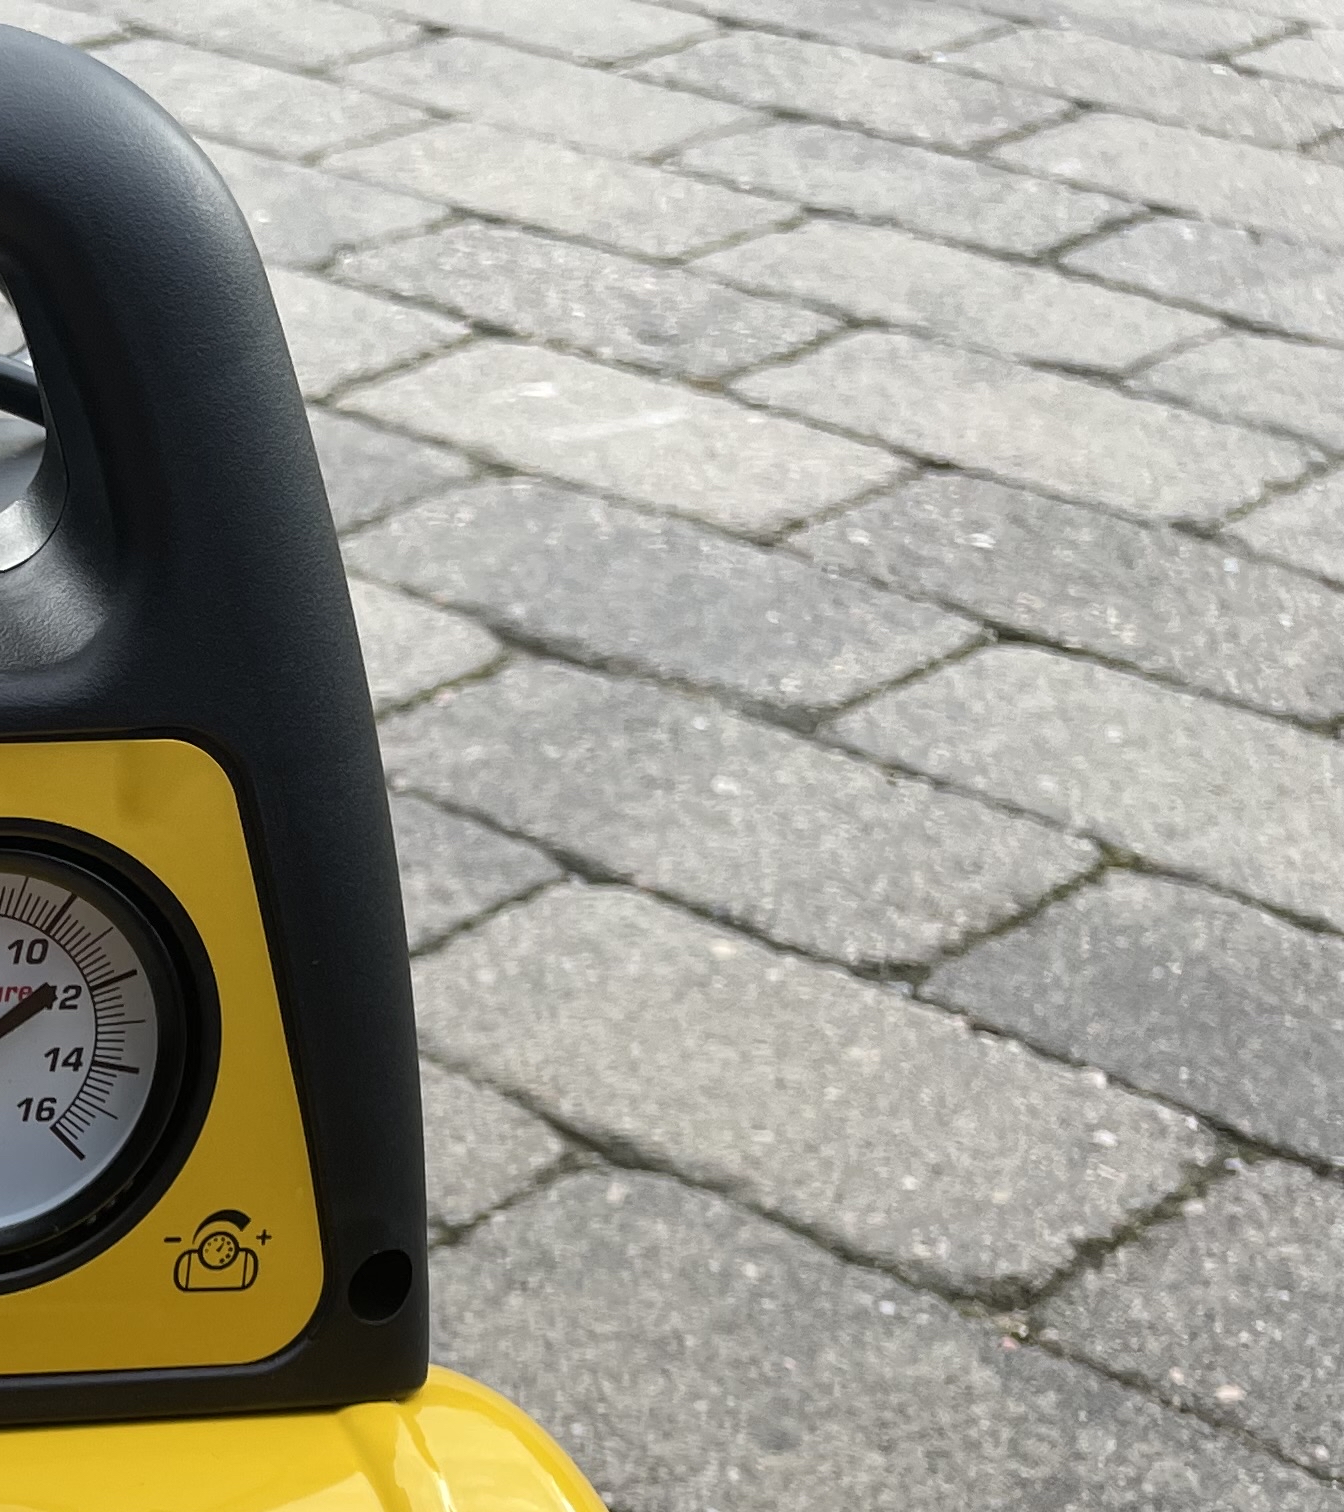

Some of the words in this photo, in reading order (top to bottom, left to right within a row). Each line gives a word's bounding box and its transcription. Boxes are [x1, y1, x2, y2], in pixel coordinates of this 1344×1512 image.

[7, 938, 49, 965] 10
[43, 1046, 84, 1073] 14
[16, 1097, 57, 1123] 16
